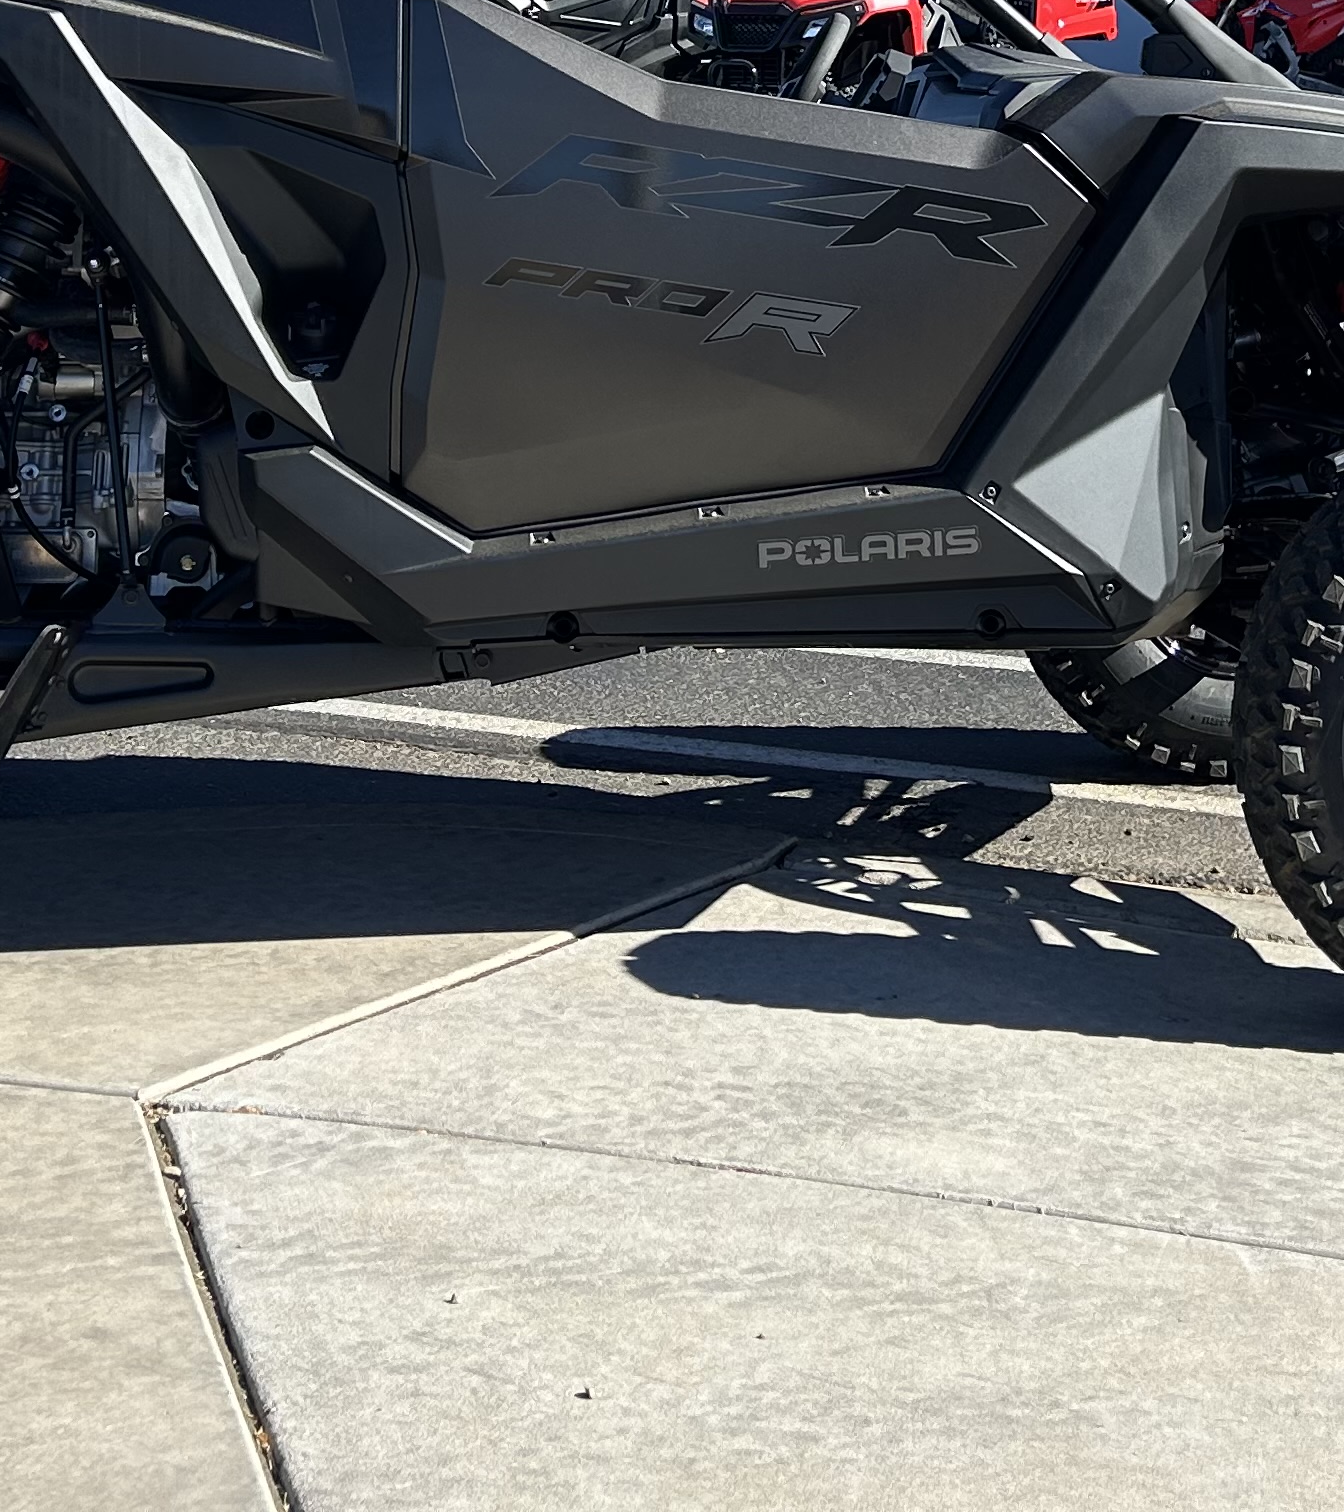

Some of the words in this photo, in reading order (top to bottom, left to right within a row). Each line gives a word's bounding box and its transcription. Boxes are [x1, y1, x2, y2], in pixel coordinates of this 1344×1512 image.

[487, 134, 1049, 268] RZR
[482, 257, 735, 318] PRO
[701, 292, 861, 356] R
[758, 526, 981, 569] POLARIS
